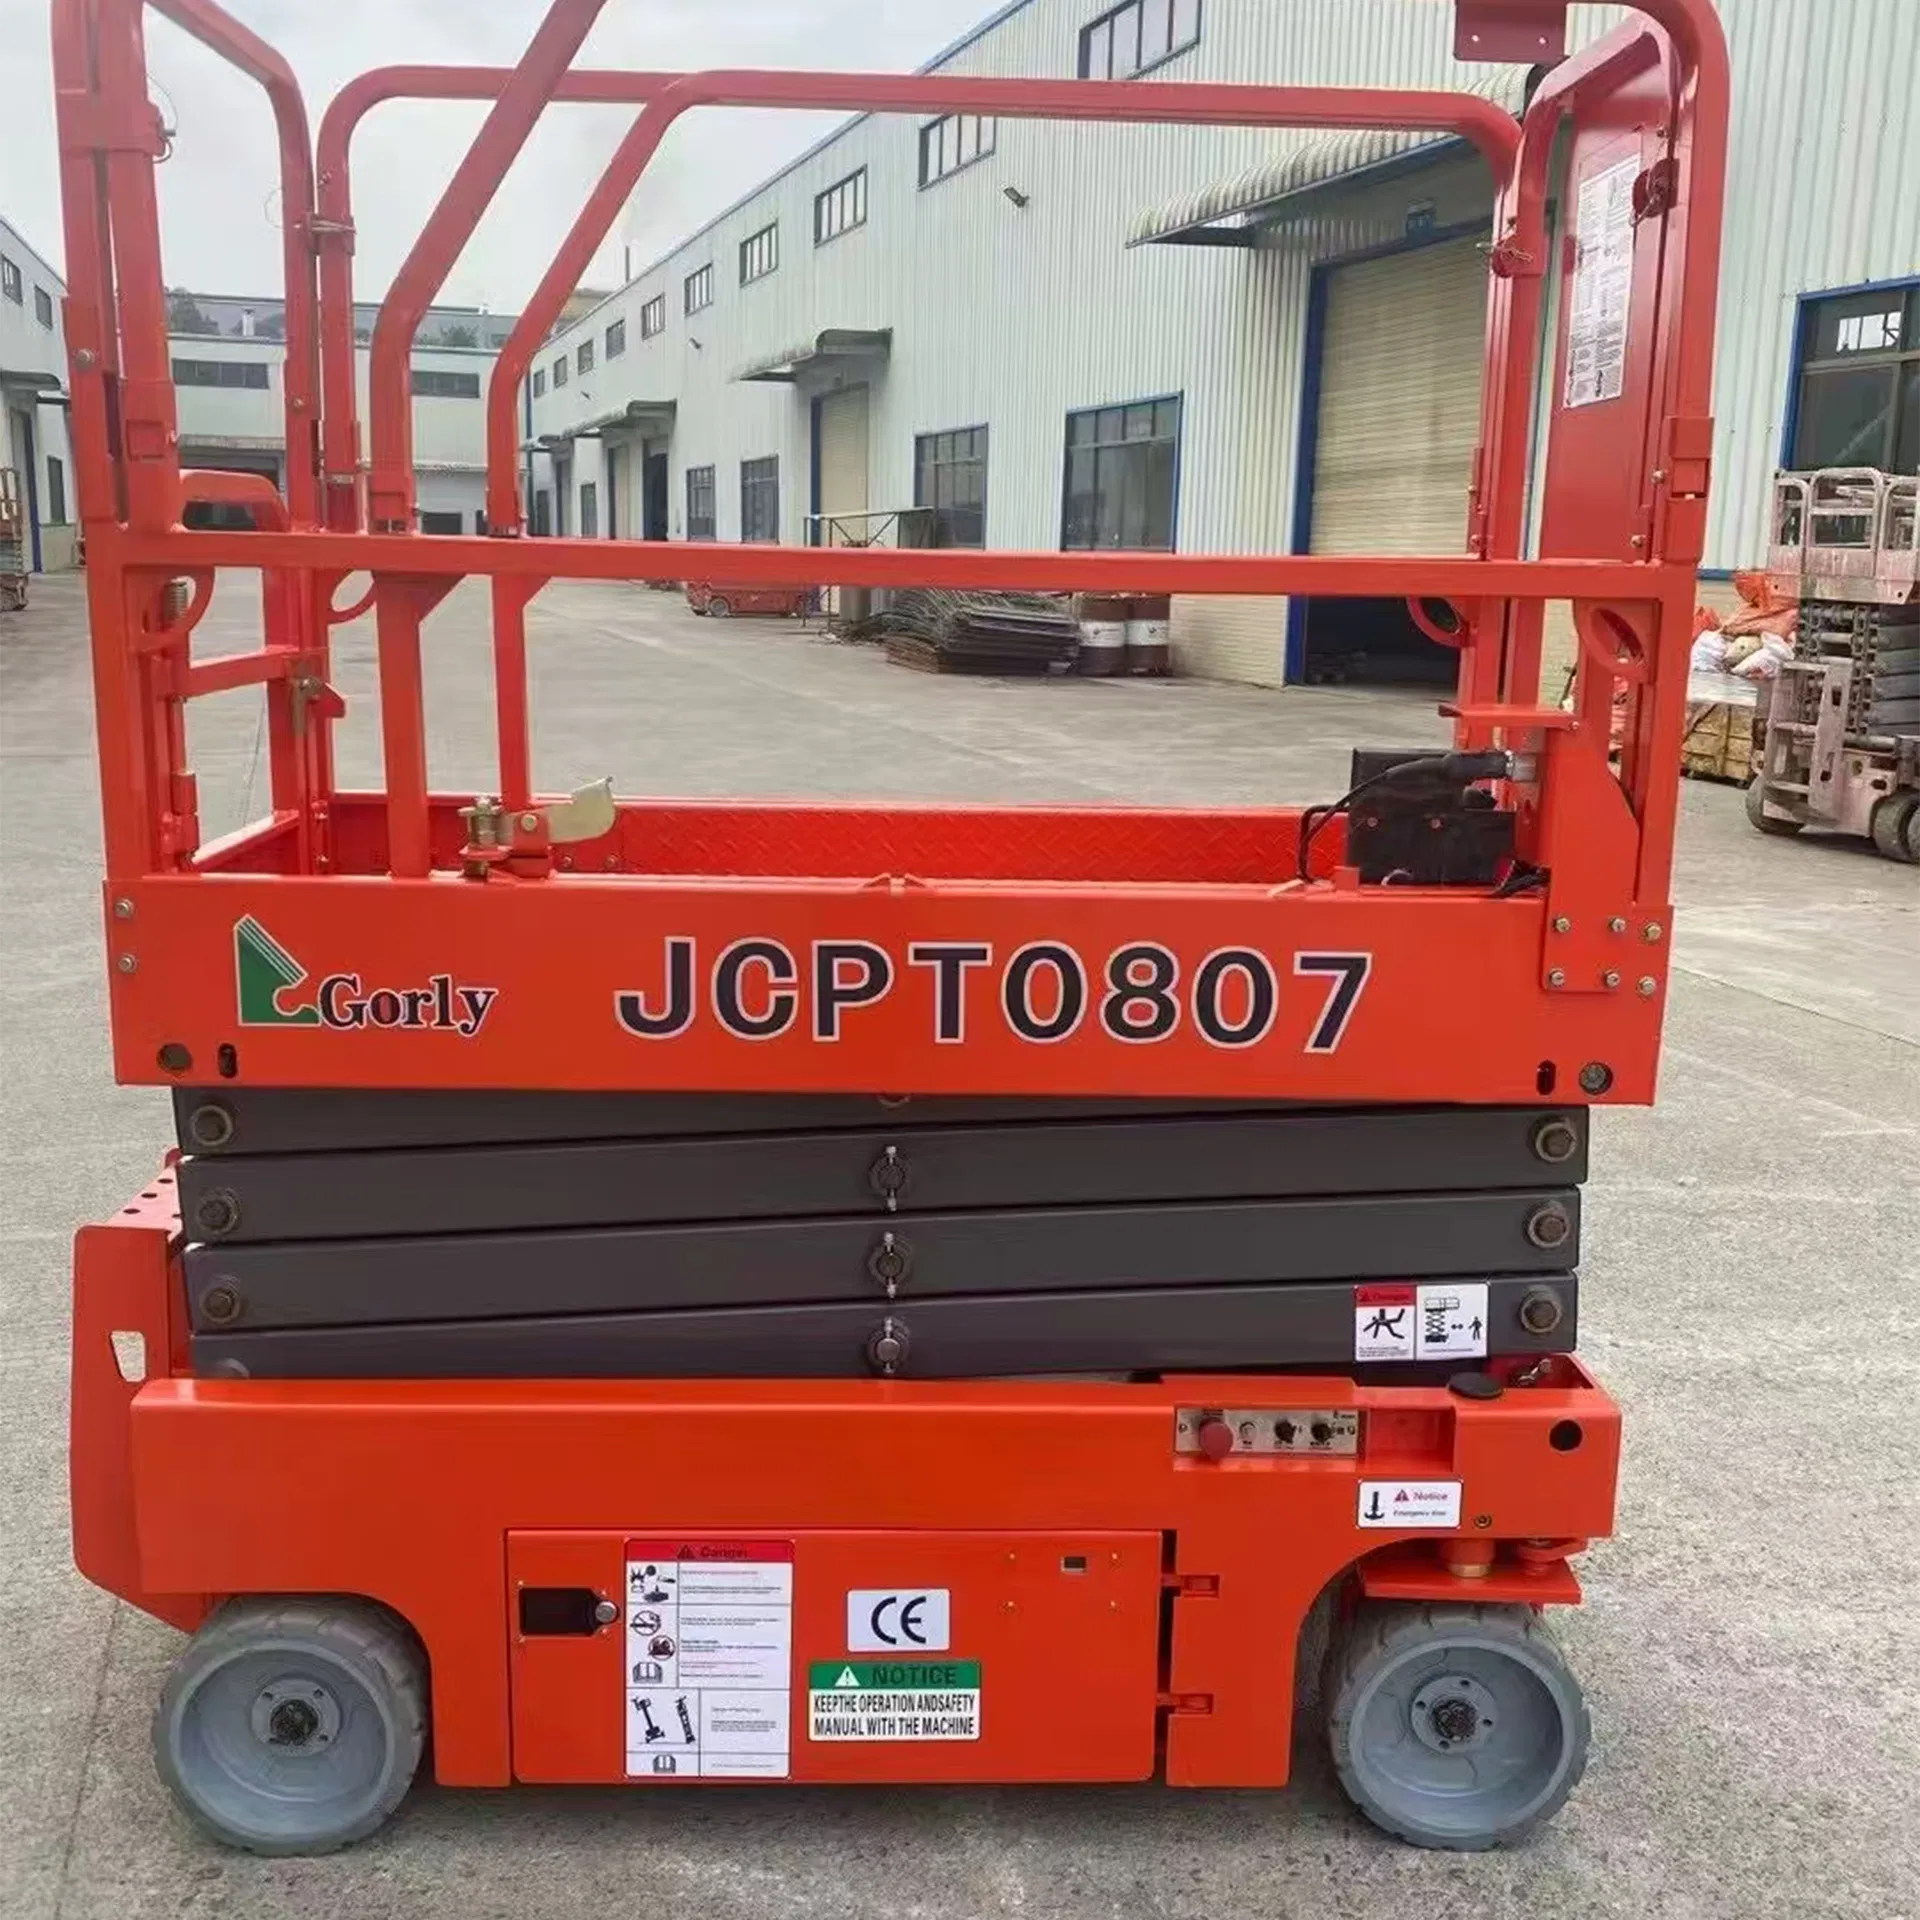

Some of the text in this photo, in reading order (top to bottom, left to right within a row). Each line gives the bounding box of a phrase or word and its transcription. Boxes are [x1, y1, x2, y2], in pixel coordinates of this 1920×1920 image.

[318, 973, 499, 1037] Gorly
[614, 936, 1373, 1055] JCPT0807
[871, 1596, 927, 1645] CE
[872, 1665, 958, 1685] NOTICE
[859, 1694, 915, 1713] OPERATION
[814, 1717, 974, 1736] MANUAL WITH THE MACHINE
